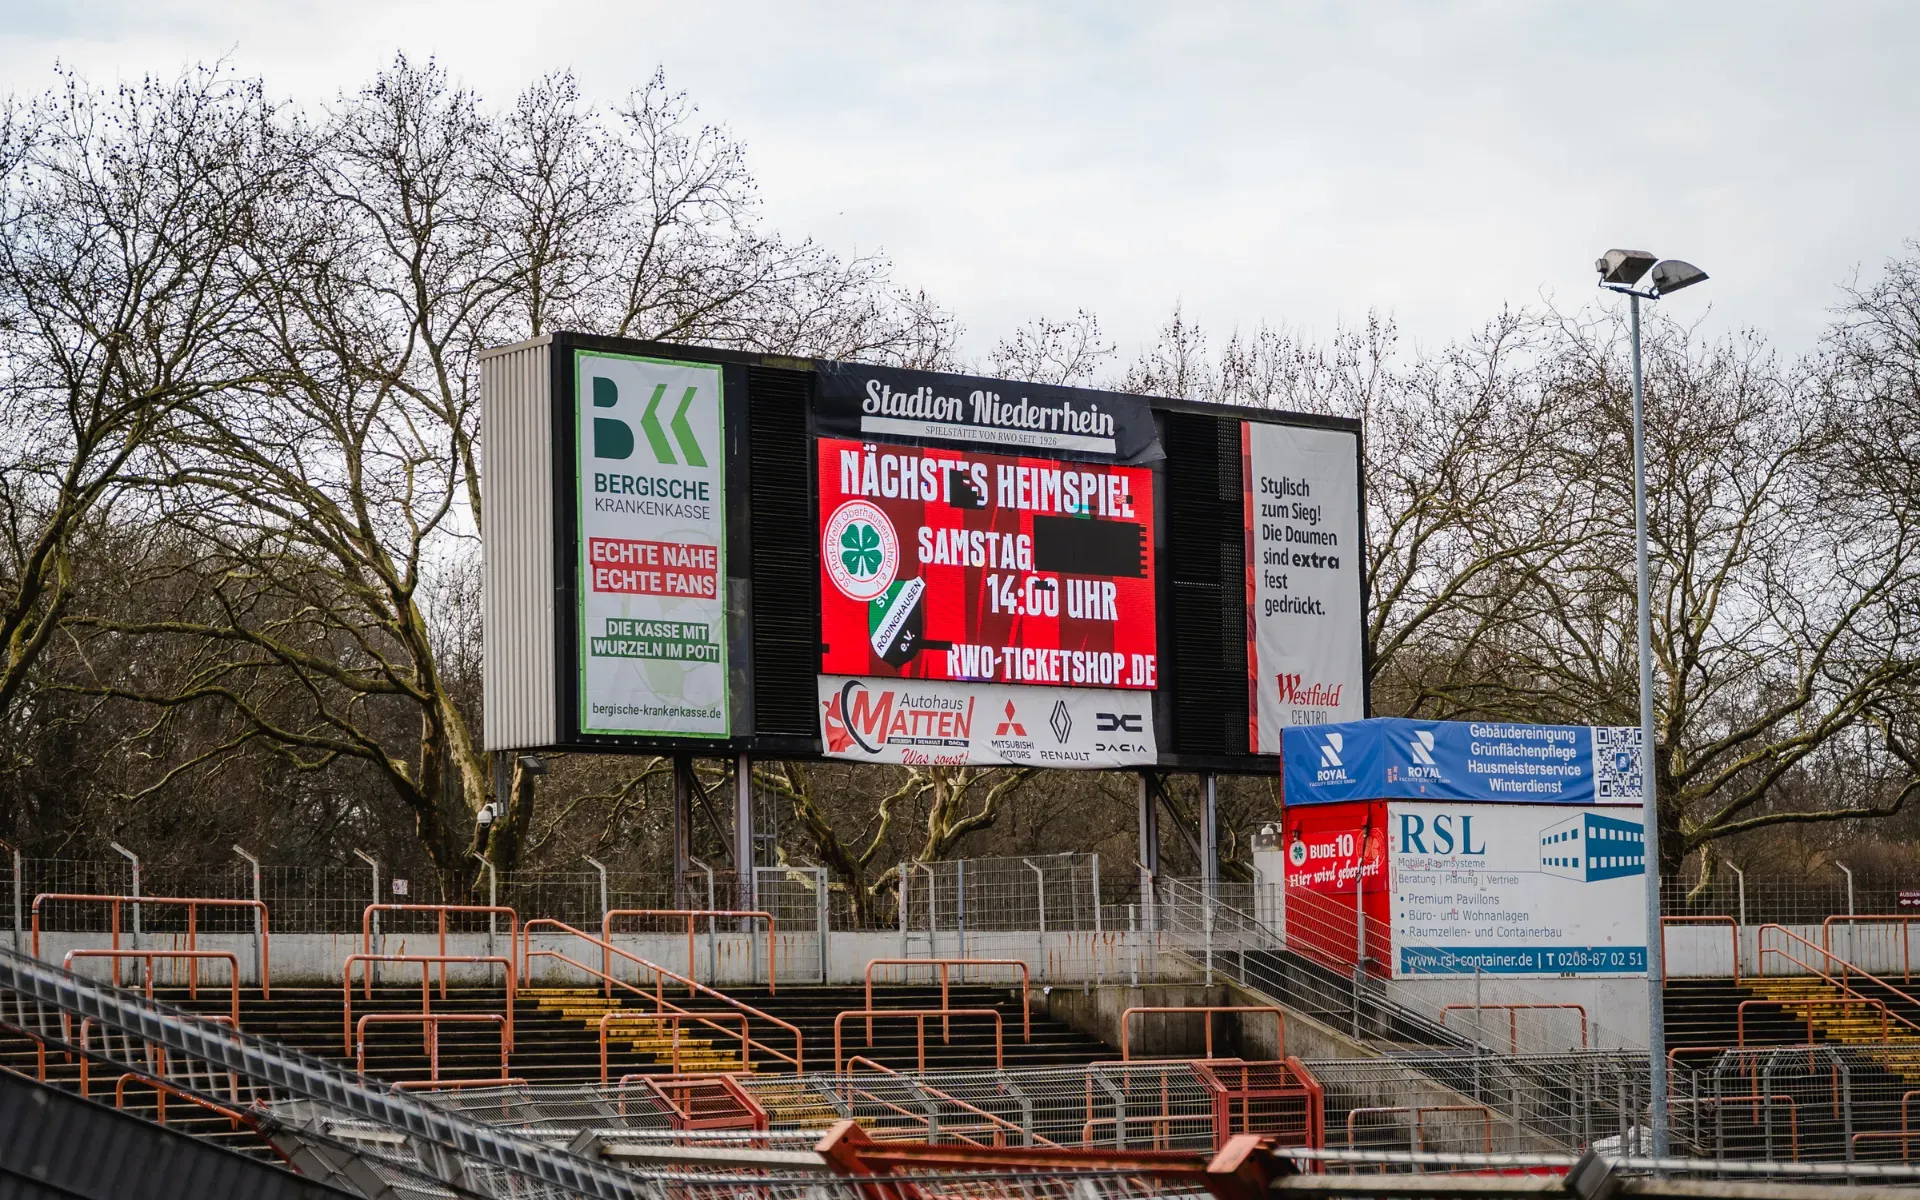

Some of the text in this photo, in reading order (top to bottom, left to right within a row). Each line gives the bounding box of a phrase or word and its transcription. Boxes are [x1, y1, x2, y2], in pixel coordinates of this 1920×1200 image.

[862, 379, 1115, 436] Stadion Niederrhein
[979, 430, 996, 440] VON
[998, 431, 1017, 442] RWO
[1018, 434, 1036, 444] SEIT
[1040, 436, 1057, 446] 1926
[594, 472, 710, 501] BERGISCHE
[997, 464, 1134, 518] HEIMSPIEL
[1261, 476, 1310, 499] Stylisch
[595, 497, 710, 520] KRANKENKASSE
[1261, 502, 1321, 526] zum Sieg!
[1262, 524, 1338, 546] Die Daumen
[593, 541, 716, 569] ECHTE NÄHE
[1263, 547, 1340, 570] sind extra
[596, 568, 715, 596] ECHTE FANS
[1264, 569, 1288, 589] fest
[987, 574, 1118, 621] 14:00 UHR
[1265, 594, 1326, 617] gedrückt.
[877, 580, 921, 651] RÖDINGHAUSEN
[608, 621, 707, 640] DIE KASSE MIT
[593, 639, 718, 660] WURZELN IM POTT
[947, 643, 1155, 686] RWO-TICKETSHOP.DE
[1275, 673, 1343, 707] Westfield
[592, 702, 721, 719] bergische-krankenkasse.de
[900, 693, 963, 710] Autohaus
[851, 690, 975, 744] MATTEN
[1291, 709, 1327, 725] CENTRO
[1470, 723, 1576, 743] Gebäudereinigung
[991, 740, 1035, 750] MITSUBISHI
[1000, 750, 1031, 759] MOTORS
[1096, 743, 1147, 753] DACIA
[1470, 741, 1577, 761] Grünflächenpflege
[901, 748, 969, 766] Was sonst!
[1041, 751, 1090, 761] RENAULT
[1317, 768, 1347, 781] ROYAL
[1407, 766, 1441, 778] ROYAL
[1468, 760, 1581, 776] Hausmeisterservice
[1489, 778, 1562, 794] Winterdienst
[1398, 813, 1486, 855] RSL
[1309, 834, 1354, 859] BUDE 10
[1398, 857, 1485, 870] Mobile Raumsysteme
[1289, 869, 1312, 888] Hier
[1313, 862, 1337, 883] wird
[1398, 874, 1436, 886] Beratung
[1445, 874, 1478, 886] Planung
[1486, 875, 1519, 885] Vertrieb
[1408, 893, 1500, 905] Premium Pavillons
[1408, 909, 1529, 924] Büro- und Wohnanlagen
[1409, 926, 1562, 938] Raumzellen- und Containerbau
[1407, 952, 1642, 967] www.rsl-container.de T 0208-87 02 51
